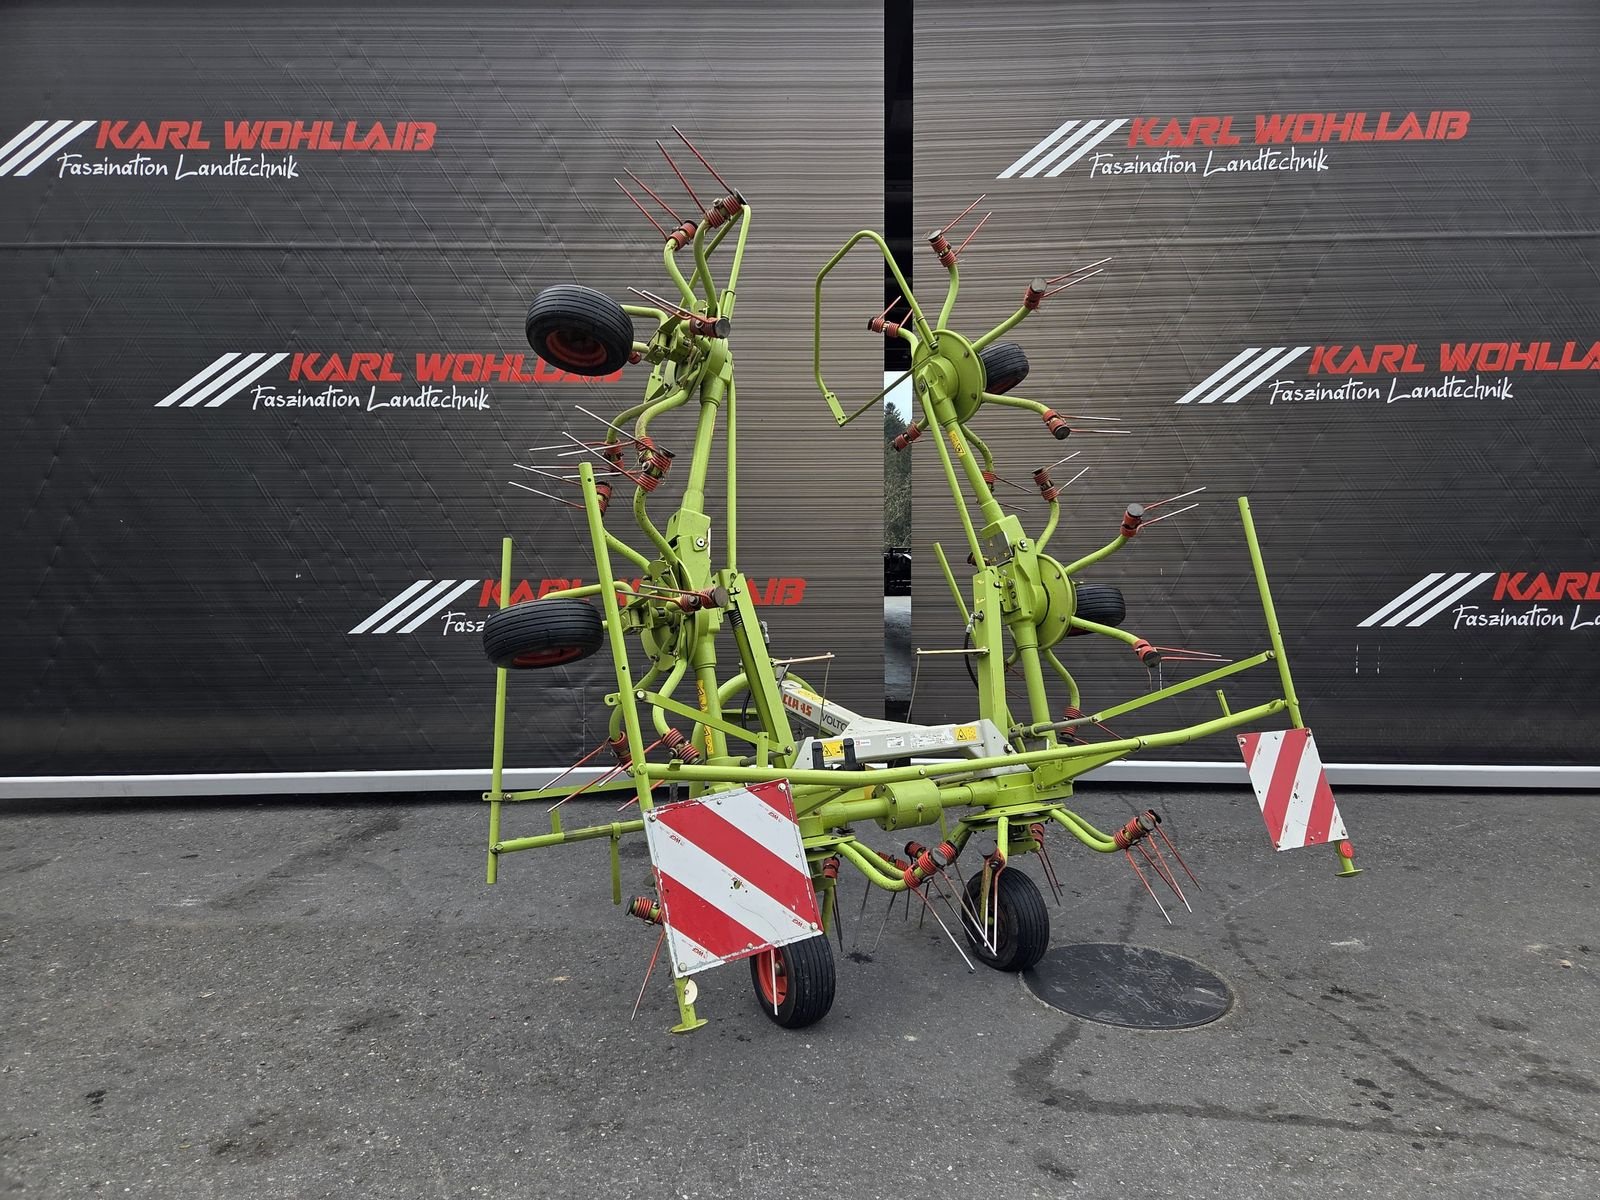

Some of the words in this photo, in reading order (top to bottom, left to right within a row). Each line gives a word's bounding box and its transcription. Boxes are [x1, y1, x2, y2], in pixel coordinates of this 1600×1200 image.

[95, 120, 210, 150] KARL
[224, 120, 437, 151] WOHLLAIB
[1126, 117, 1241, 147] KARL
[1255, 110, 1470, 145] WOHLLAIB
[56, 152, 168, 179] Faszination
[174, 153, 299, 181] Landtechnik
[1088, 150, 1198, 179] Faszination
[1202, 146, 1329, 178] Landtechnik
[289, 352, 403, 382] KARL
[415, 352, 624, 383] WOHLL
[1307, 343, 1426, 376] KARL
[250, 383, 361, 411] Faszination
[366, 384, 491, 412] Landtechnik
[1268, 376, 1381, 405] Faszination
[1386, 374, 1514, 404] Landtechnik
[1492, 571, 1600, 601] KARL
[1452, 604, 1564, 630] Faszination
